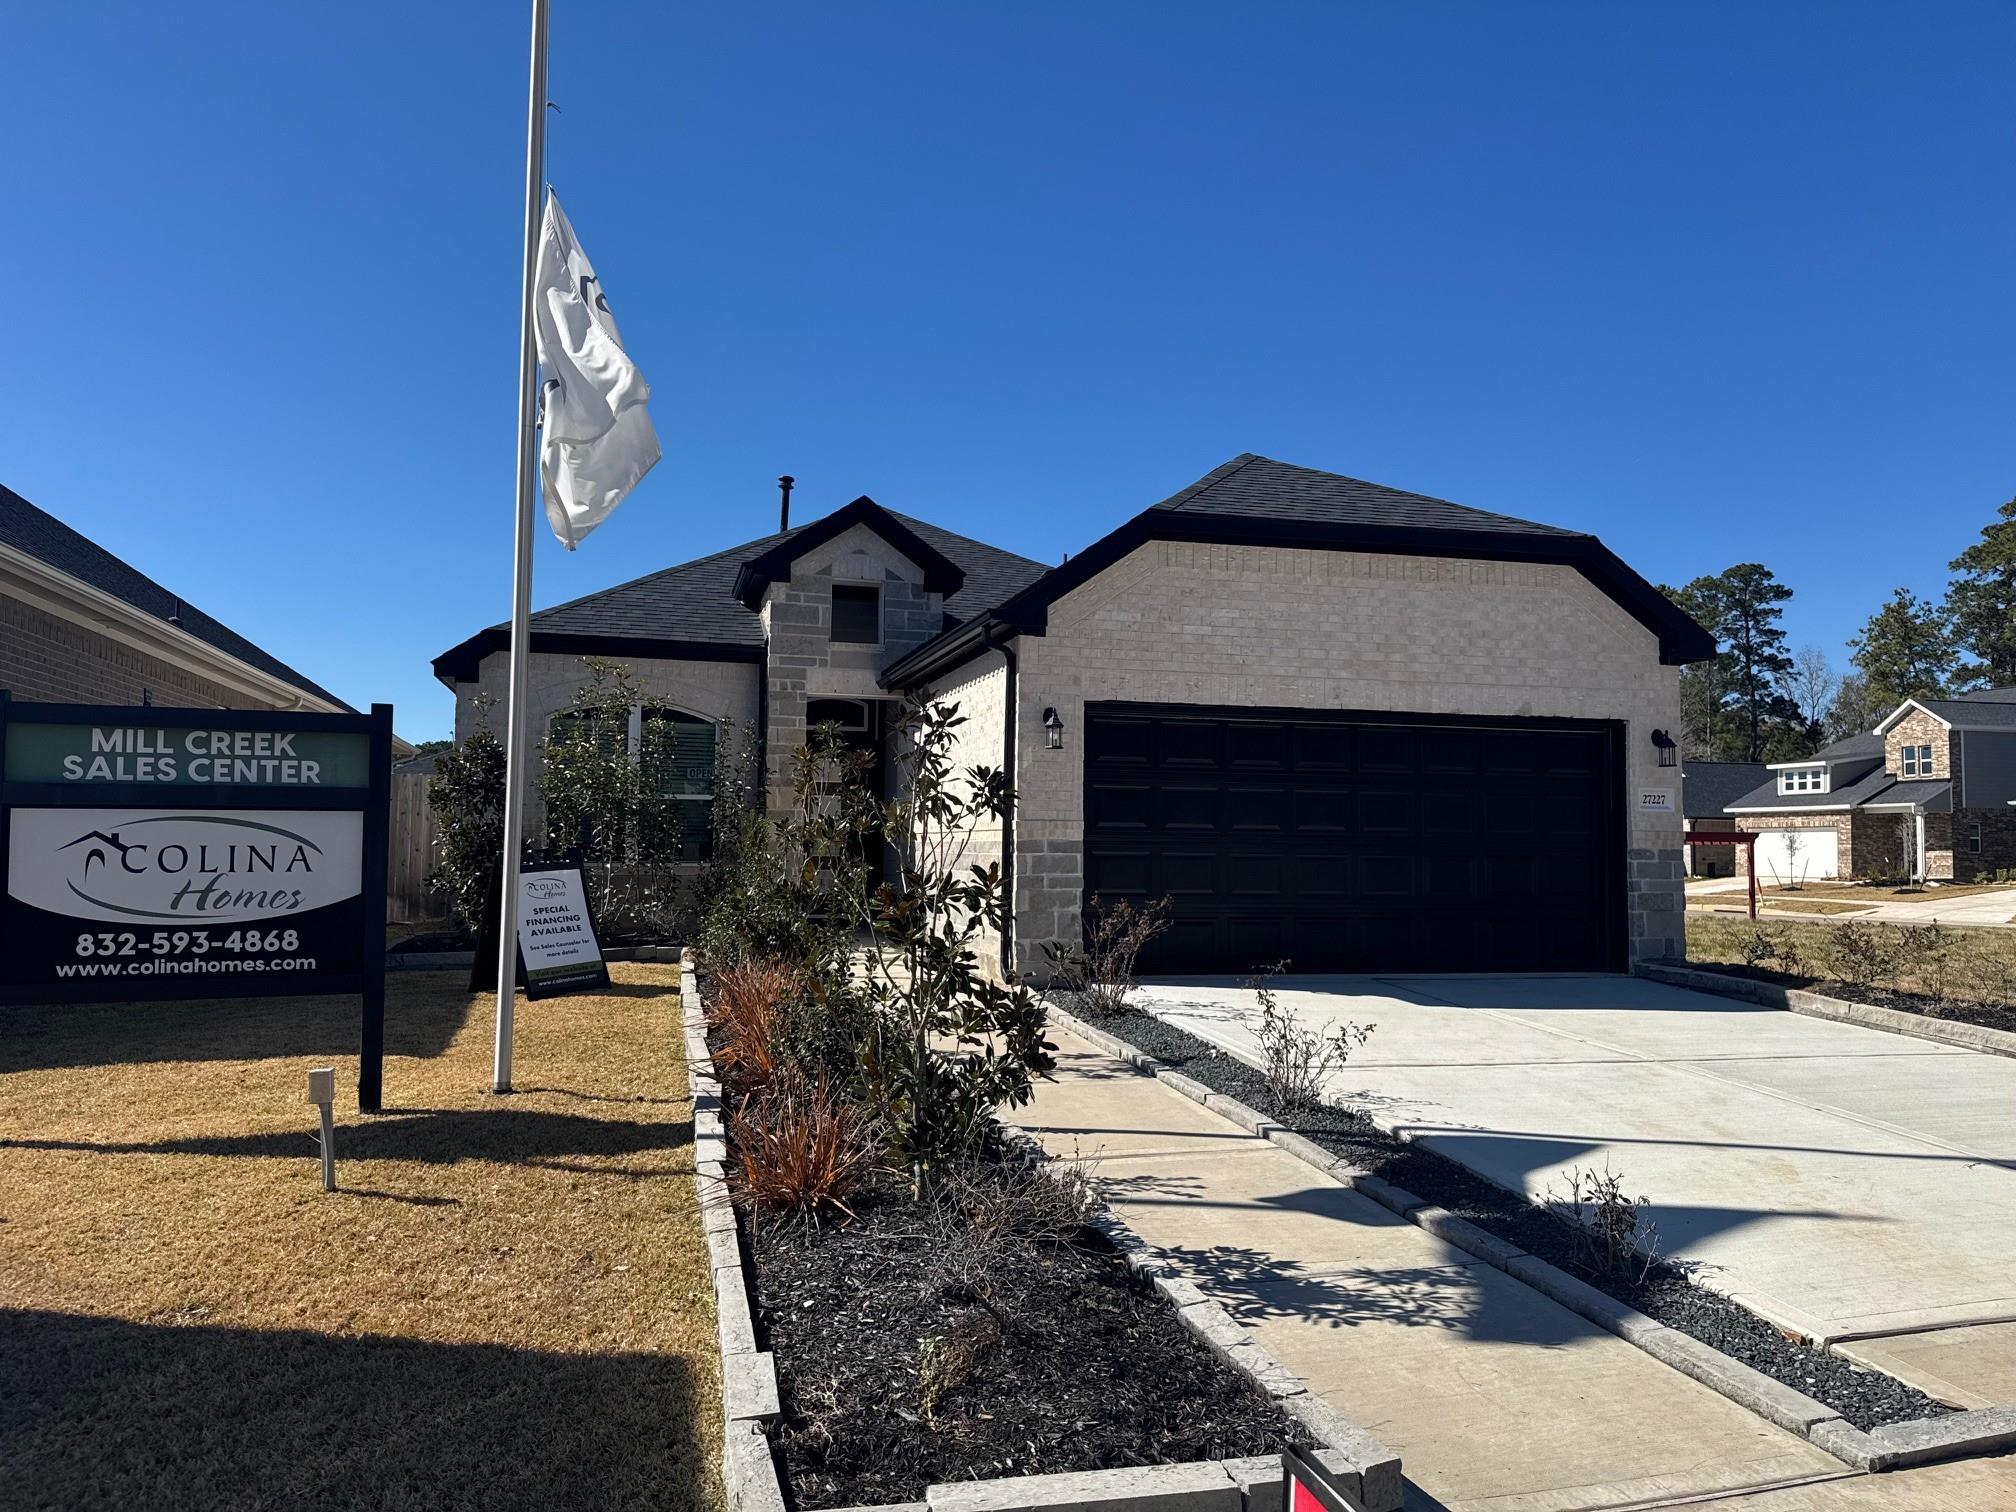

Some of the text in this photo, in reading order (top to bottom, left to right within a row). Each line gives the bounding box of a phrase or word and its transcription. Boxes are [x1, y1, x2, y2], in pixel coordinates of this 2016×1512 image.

[91, 728, 297, 757] MILL CREEK
[62, 755, 321, 784] SALES CENTER
[1642, 794, 1666, 805] 27227
[120, 844, 314, 874] COLINA
[169, 873, 305, 912] Homes
[534, 882, 567, 892] COLINA
[526, 914, 580, 926] FINANCING
[533, 905, 570, 914] SPECIAL
[531, 925, 581, 936] AVAILABLE
[75, 929, 300, 957] 832-593-4868
[55, 956, 316, 978] www.colinahomes.com
